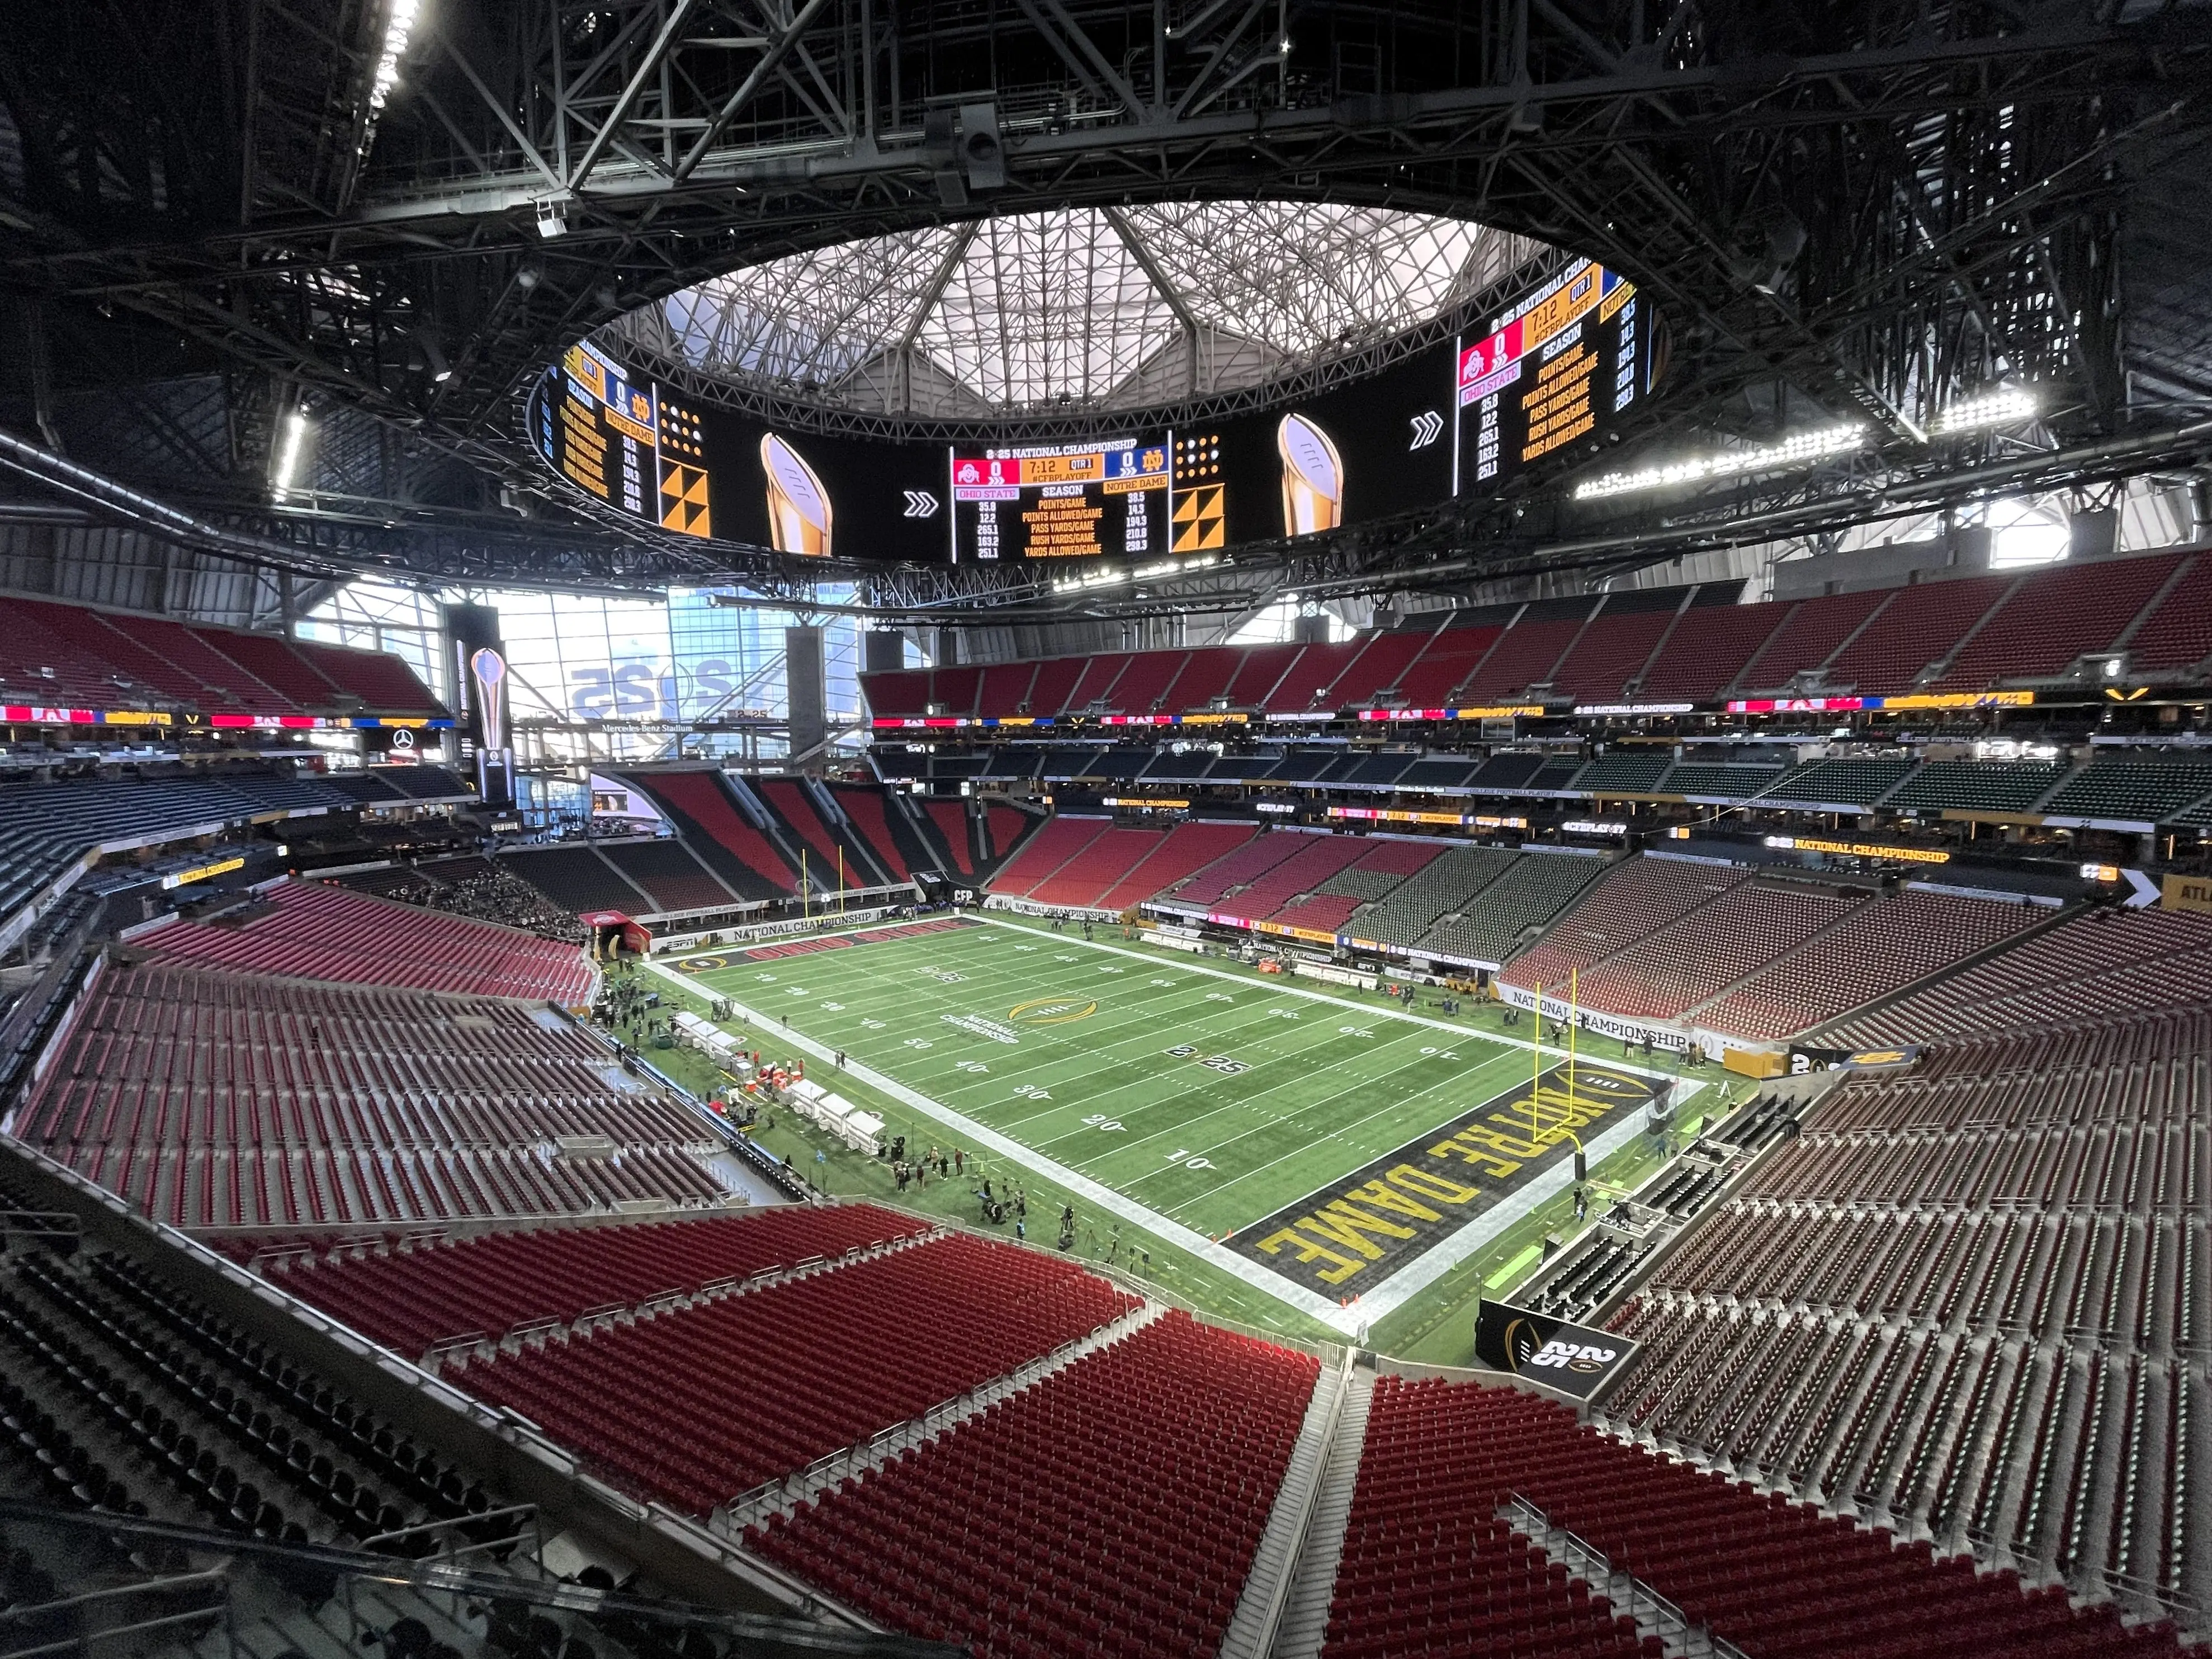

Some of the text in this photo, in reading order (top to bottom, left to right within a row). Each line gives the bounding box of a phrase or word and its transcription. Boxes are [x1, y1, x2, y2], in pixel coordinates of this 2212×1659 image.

[1515, 278, 1564, 319] NATIONAL
[1532, 275, 1591, 331] 7:12 QTR 1
[1534, 296, 1591, 343] #CFBPLAYOFF
[1495, 333, 1506, 356] 0
[1542, 323, 1582, 361] SEASON
[1538, 341, 1585, 384] POINTS/GAME
[616, 381, 626, 403] 0
[1464, 367, 1518, 403] OHIO STATE
[1481, 393, 1499, 414] 35.8
[1522, 387, 1548, 410] POINTS
[1529, 376, 1590, 424] PASS YARDS/GAME
[607, 409, 654, 444] NOTRE DAME
[1481, 410, 1498, 430] 12.2
[1529, 395, 1590, 442] RUSH YARDS/GAME
[1477, 426, 1500, 448] 265.1
[1012, 446, 1062, 459] NATIONAL
[1062, 438, 1138, 456] CHAMPIONSHIP
[1477, 443, 1499, 465] 163.2
[1523, 441, 1544, 462] YARDS
[990, 461, 1002, 476] 0
[1029, 460, 1056, 474] 7:12
[1071, 460, 1086, 469] QTR
[1086, 459, 1092, 468] 1
[1122, 451, 1134, 468] 0
[1477, 461, 1499, 482] 251.1
[1033, 472, 1092, 483] #CFBPLAYOFF
[1107, 476, 1166, 491] NOTRE DAME
[960, 489, 1015, 498] OHIO STATE
[979, 491, 1145, 512] 35.8 POINTS/GAME 38.5
[1042, 485, 1084, 497] SEASON
[980, 504, 1145, 523] 12.2 POINTS ALLOWED/GAME 14.3
[977, 515, 1147, 535] 265.1 PASS YARDS/GAME 194.3
[977, 527, 1147, 547] 163.2 RUSH YARDS/GAME 210.8
[978, 547, 999, 559] 251.1
[1024, 547, 1047, 557] YARDS
[1048, 543, 1102, 556] ALLOWED/GAME
[602, 724, 661, 732] Mercedes-Benz
[1794, 839, 1950, 863] NATIONAL CHAMPIONSHIP
[954, 889, 973, 901] CFP
[733, 921, 792, 941] NATIONAL
[1407, 948, 1501, 972] NATIONAL CHAMPIONSHIP
[1513, 991, 1570, 1020] NATONAL
[939, 1014, 1019, 1044] CHAMPIONSHIP
[965, 1013, 1018, 1037] NATIONAL
[903, 1038, 933, 1050] 50
[954, 1060, 987, 1073] 40
[1013, 1084, 1049, 1100] 30
[1080, 1113, 1123, 1132] 20
[1164, 1148, 1210, 1170] 10
[1255, 1163, 1482, 1285] DAME
